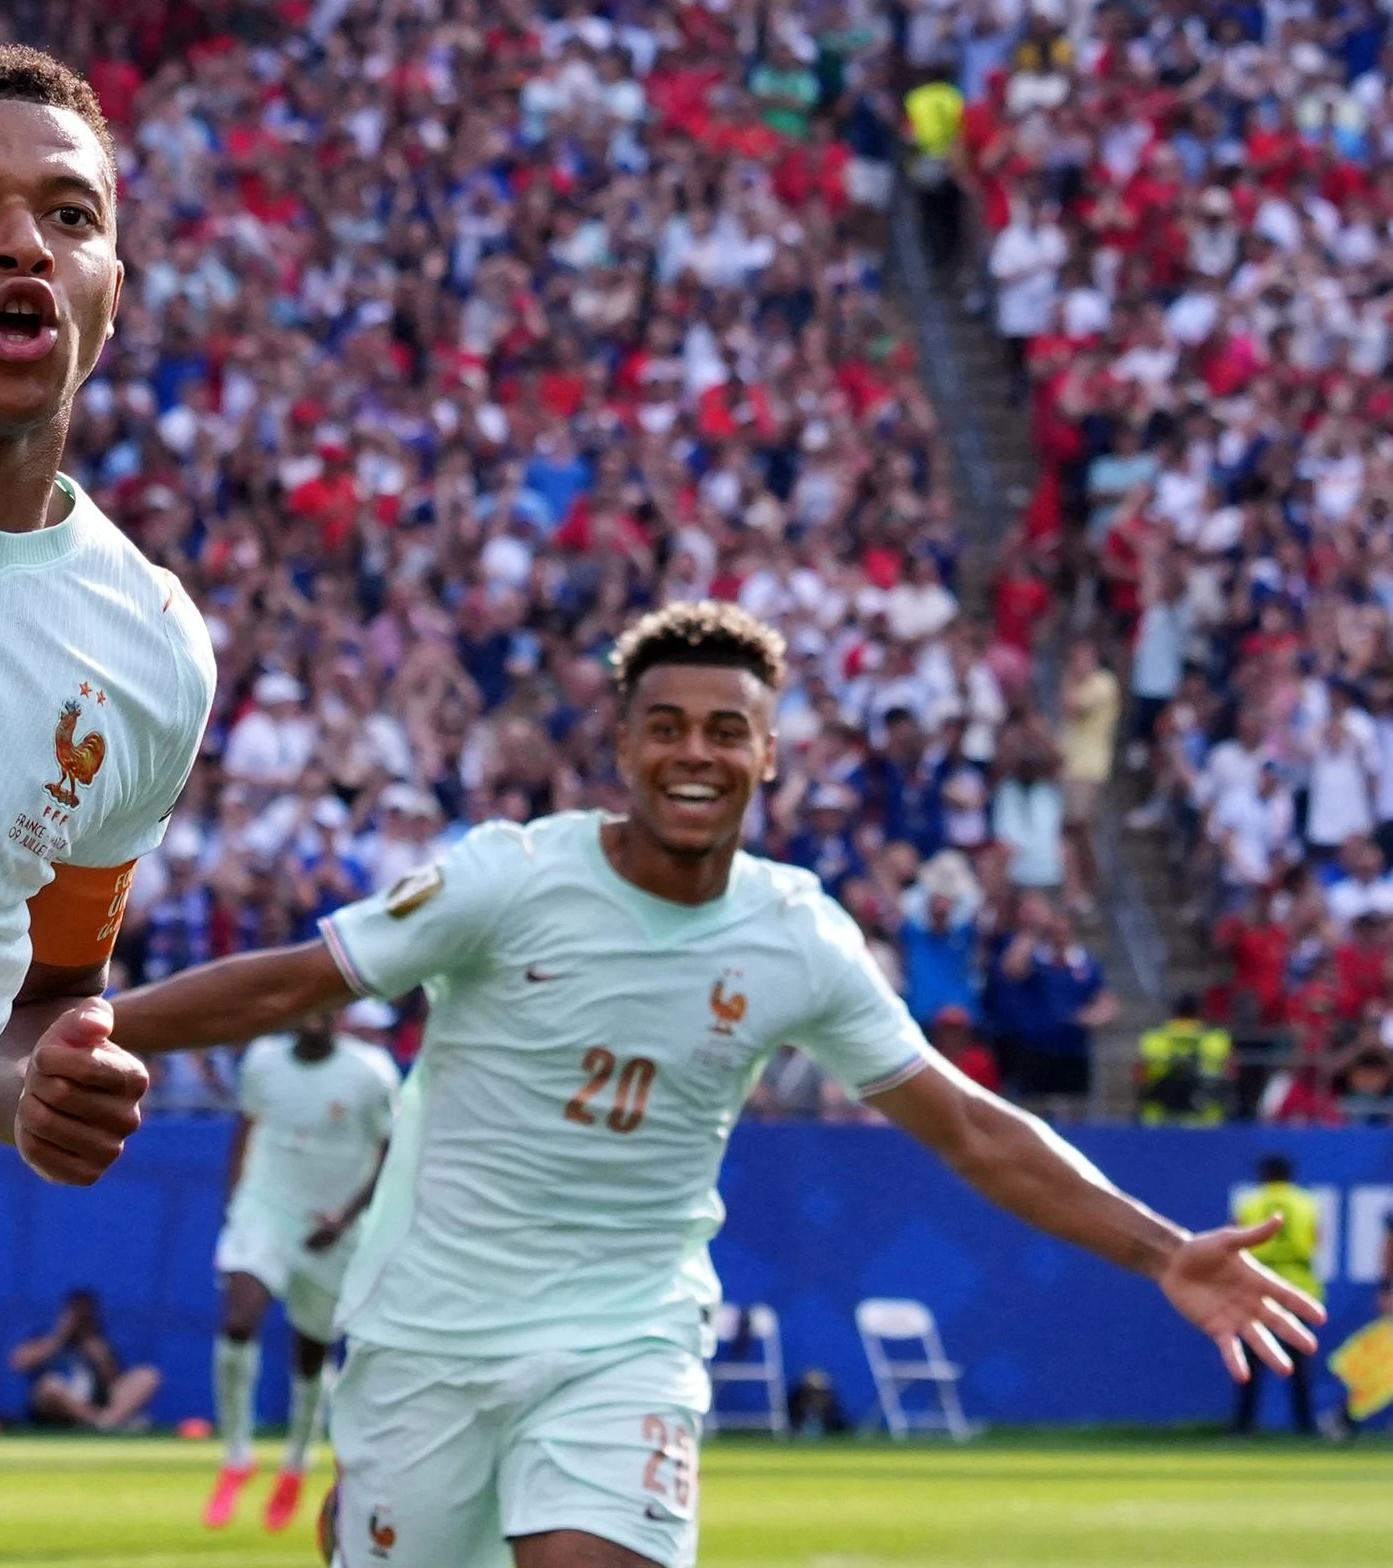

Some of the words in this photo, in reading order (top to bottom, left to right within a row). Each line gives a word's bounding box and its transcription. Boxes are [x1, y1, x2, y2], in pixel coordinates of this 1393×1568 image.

[15, 812, 47, 839] FRANCE
[8, 826, 22, 840] 09
[19, 835, 48, 857] JUILLE
[563, 1044, 658, 1135] 20
